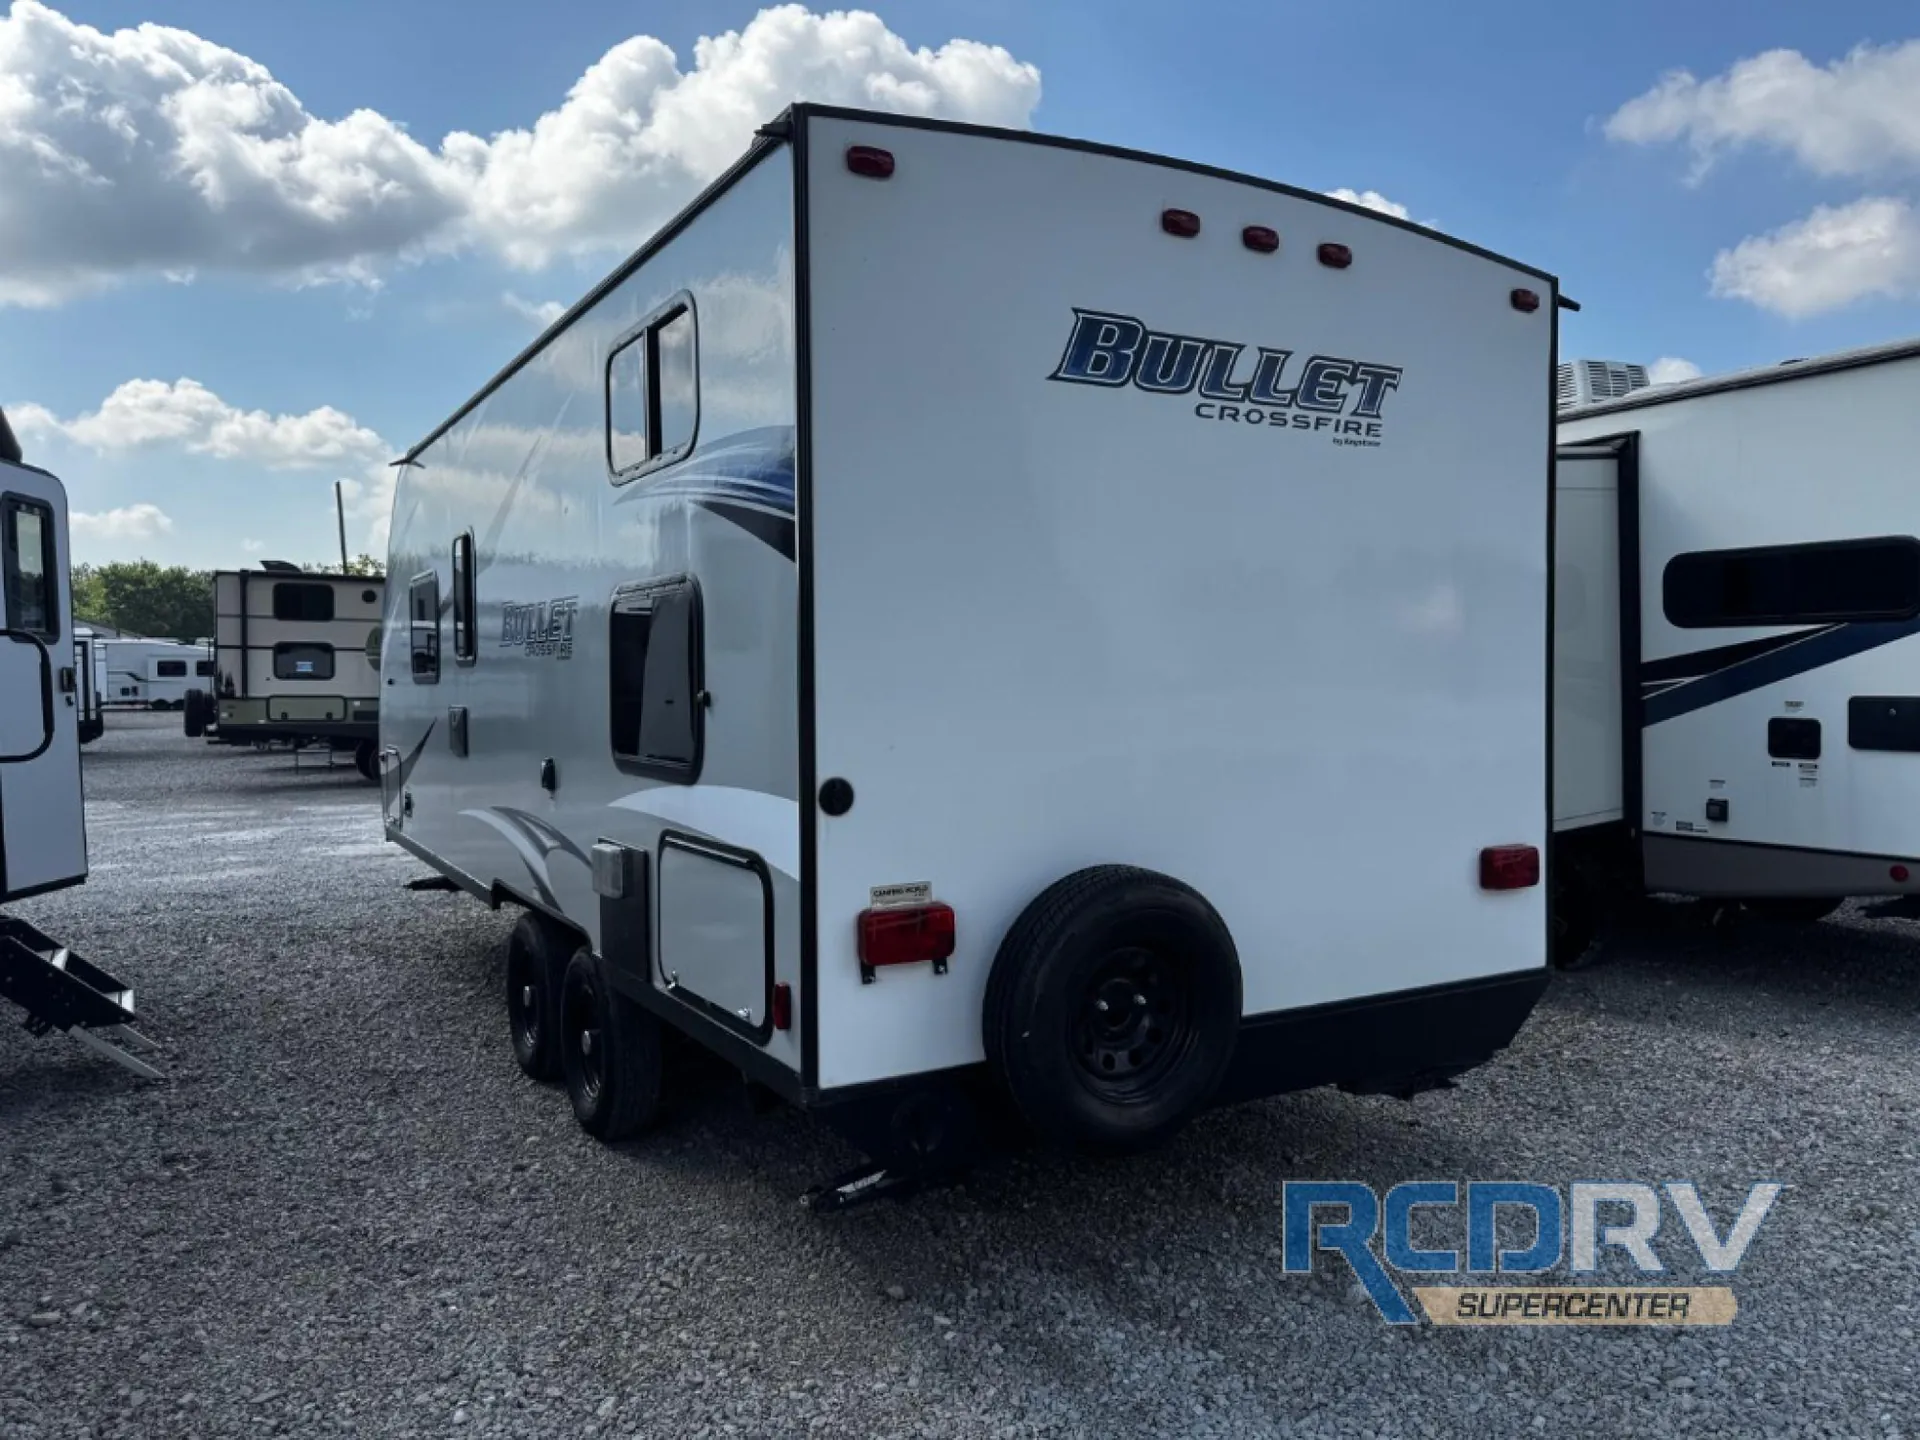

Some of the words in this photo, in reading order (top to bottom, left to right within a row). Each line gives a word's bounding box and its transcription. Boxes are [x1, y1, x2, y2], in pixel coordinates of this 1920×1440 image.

[1046, 307, 1403, 418] BULLET
[1194, 402, 1383, 438] CROSSFIRE
[499, 594, 578, 647] BULLET
